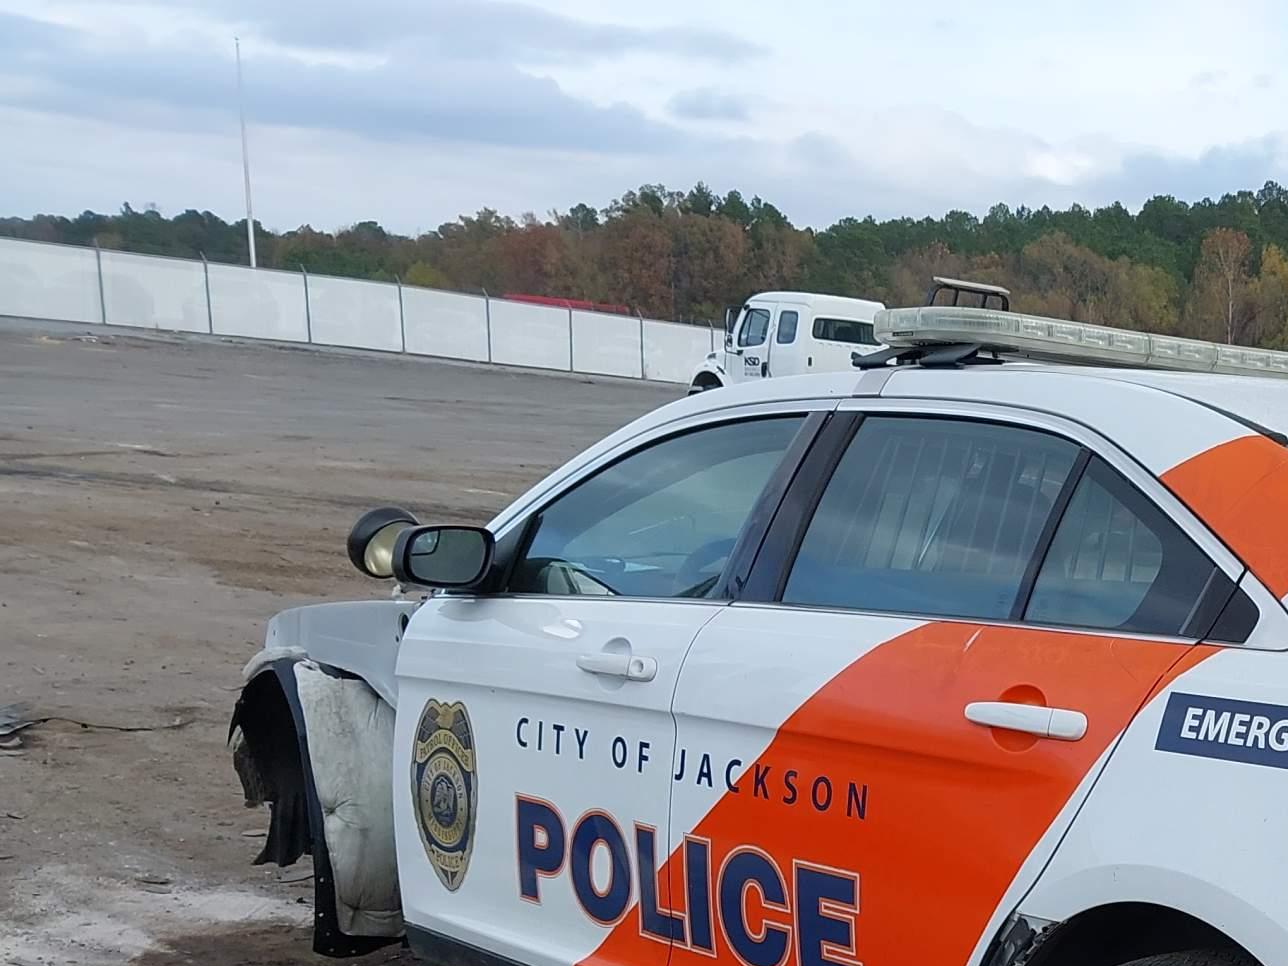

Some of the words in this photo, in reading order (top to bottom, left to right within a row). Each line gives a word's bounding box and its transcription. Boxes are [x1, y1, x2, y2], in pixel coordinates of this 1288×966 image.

[516, 716, 589, 761] CITY
[612, 736, 651, 773] OF
[674, 749, 869, 820] JACKSON
